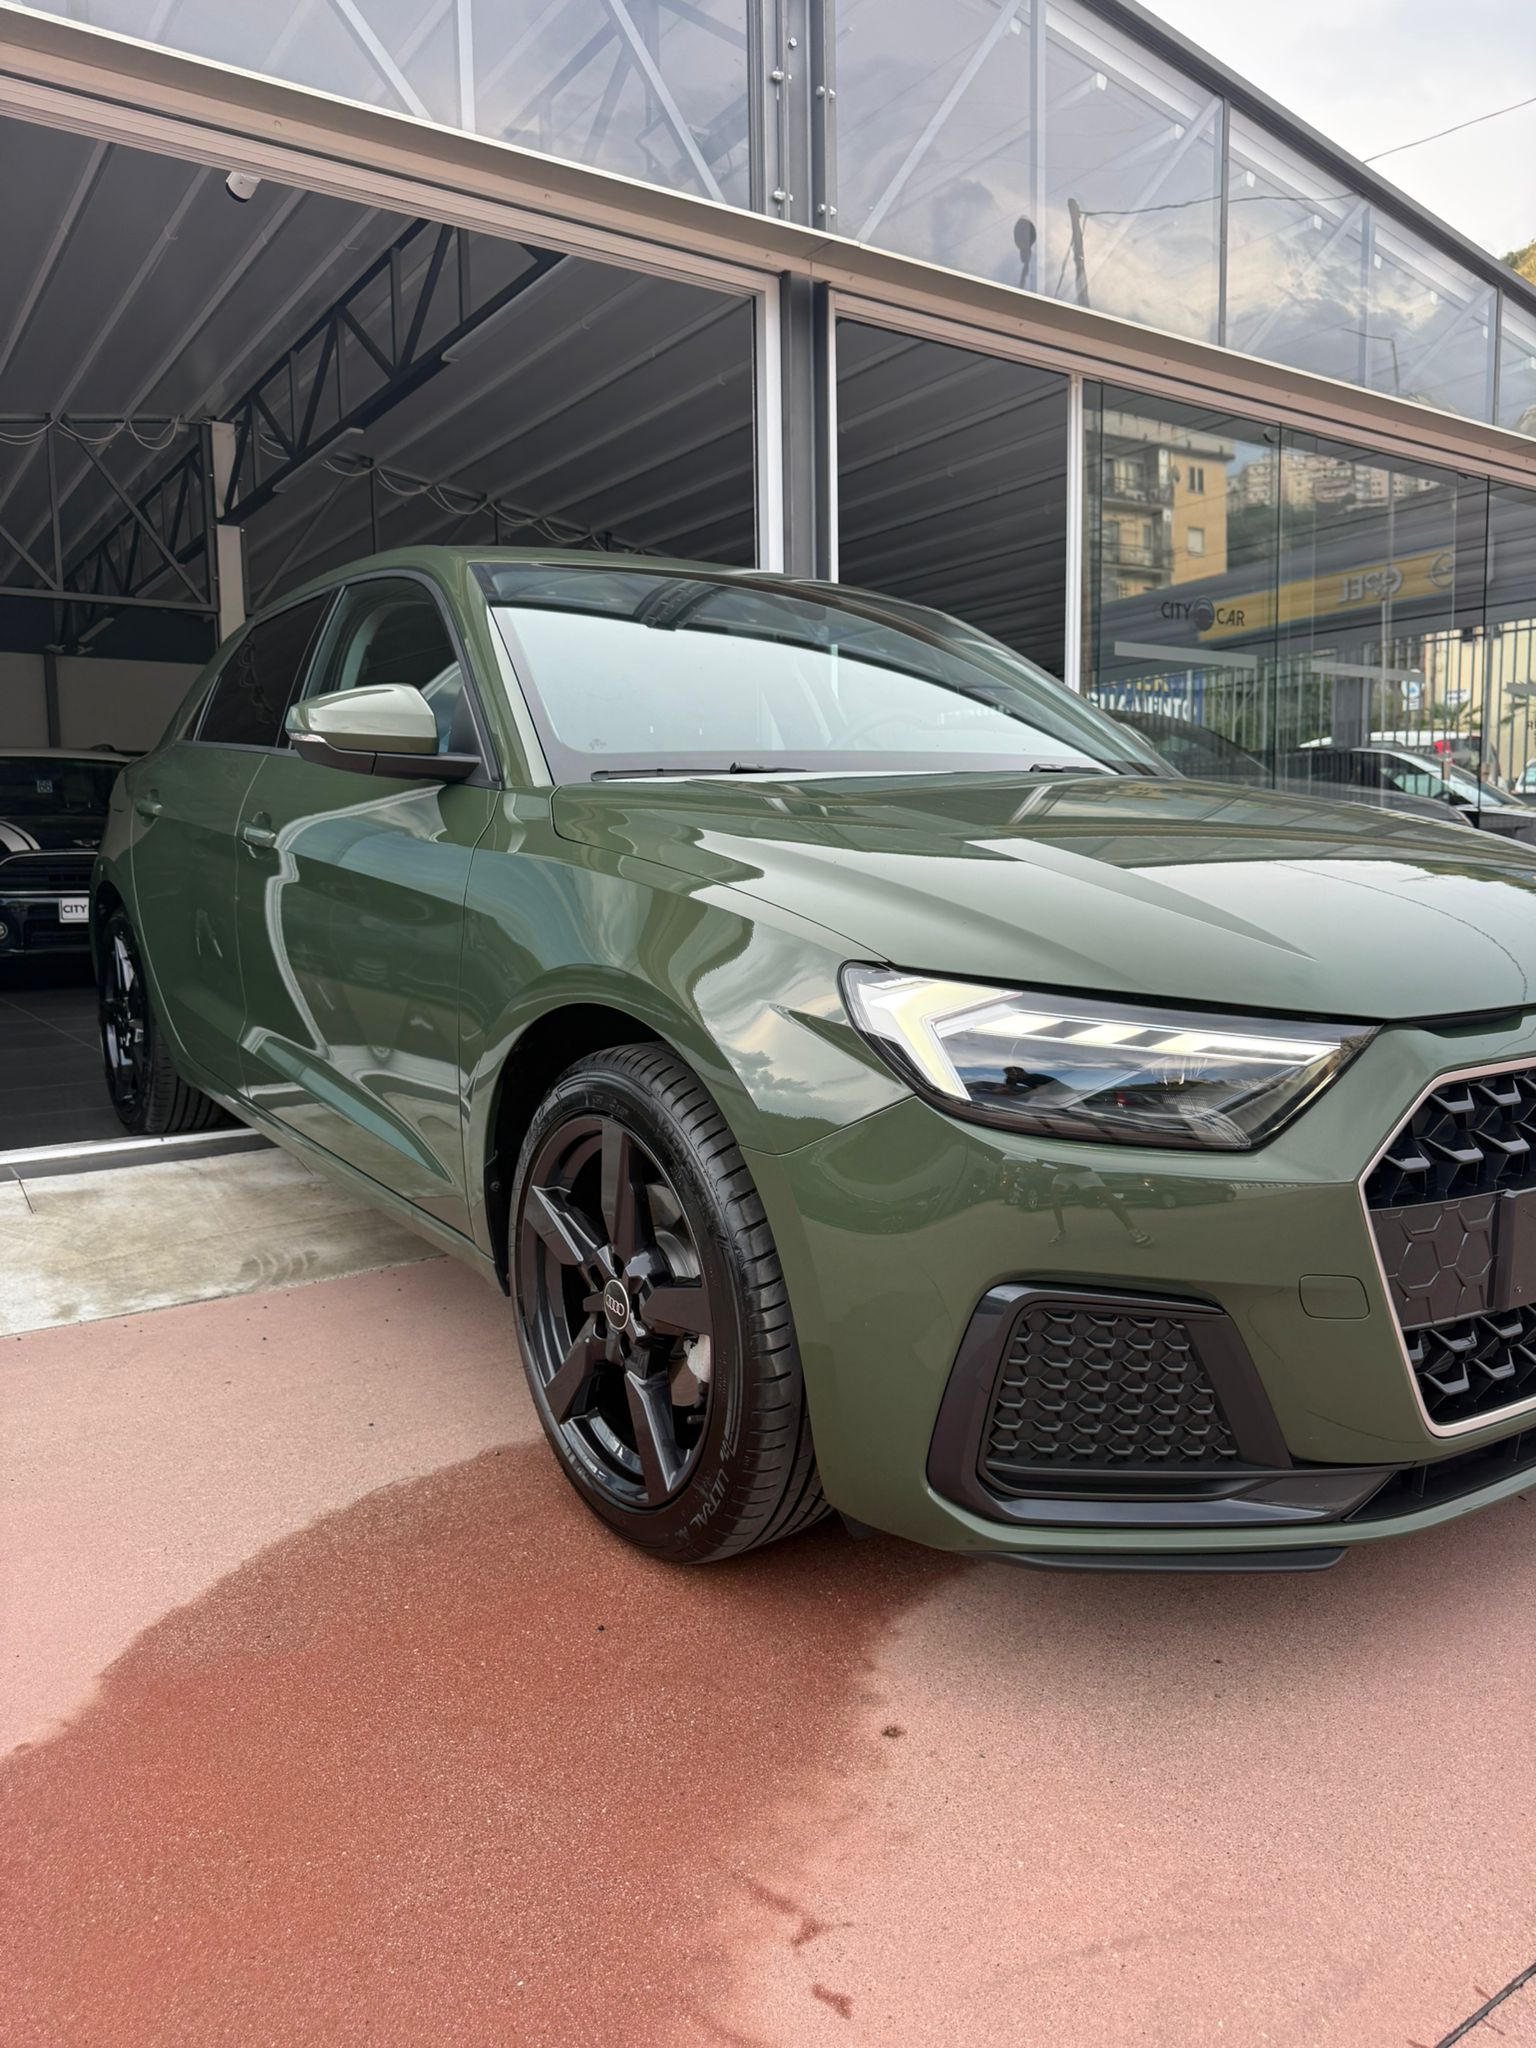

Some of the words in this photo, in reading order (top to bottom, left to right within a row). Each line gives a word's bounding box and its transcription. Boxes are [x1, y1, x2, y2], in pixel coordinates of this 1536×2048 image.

[1160, 601, 1192, 620] CITY
[1216, 607, 1246, 627] CAR
[62, 904, 87, 914] CITY
